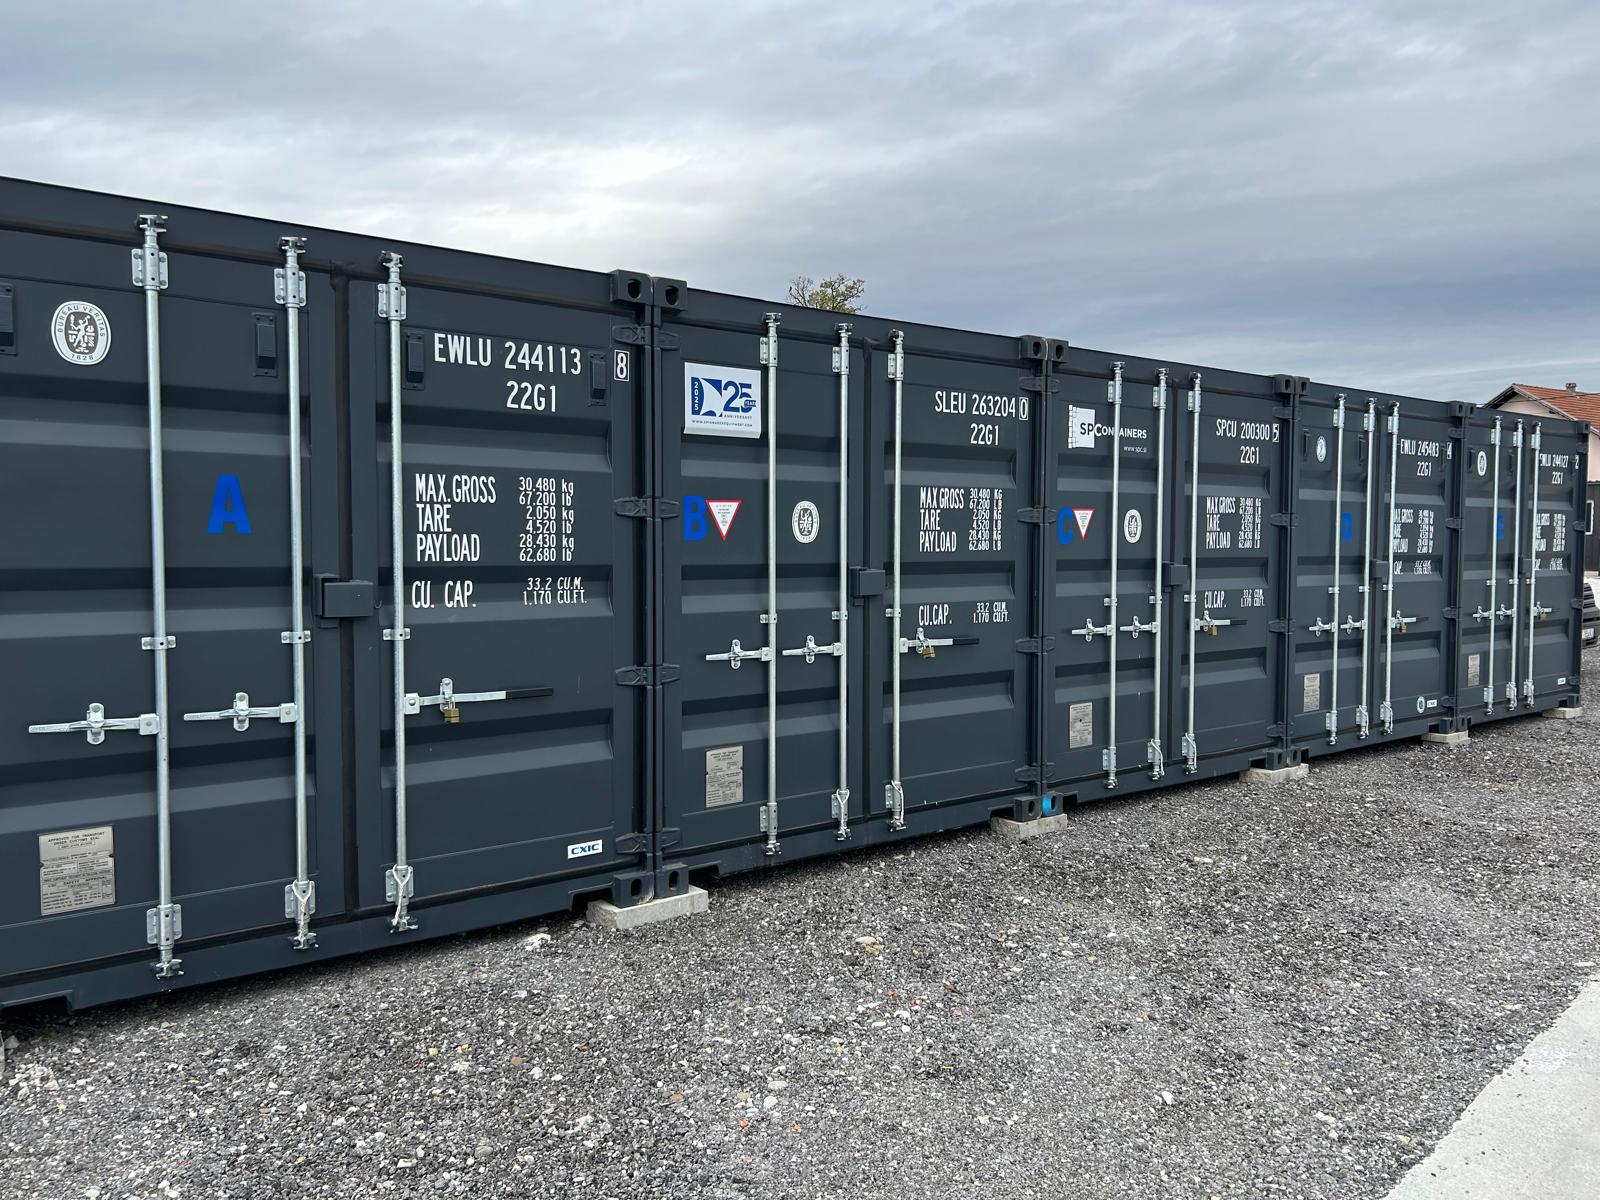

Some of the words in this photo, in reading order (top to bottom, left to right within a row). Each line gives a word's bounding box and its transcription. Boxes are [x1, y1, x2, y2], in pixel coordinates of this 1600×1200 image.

[434, 332, 492, 367] EWLU
[504, 341, 582, 375] 244113
[616, 352, 627, 379] 8
[506, 380, 557, 412] 22G1
[723, 380, 753, 413] 25
[935, 390, 967, 414] SLEU
[971, 393, 1016, 418] 263204
[1020, 398, 1027, 419] 0
[970, 423, 999, 446] 22G1
[1080, 422, 1147, 439] SPCONAINERS
[1216, 418, 1237, 438] SPCU
[1240, 422, 1270, 440] 200300
[1240, 445, 1259, 464] 22G1
[1400, 439, 1416, 455] EWLU
[1416, 461, 1432, 476] 22G1
[561, 478, 574, 497] kg
[207, 473, 252, 534] A
[562, 492, 572, 506] lb
[939, 488, 965, 509] GROSS
[993, 489, 1003, 499] KG
[993, 499, 1003, 509] LB
[416, 503, 452, 532] TARE
[562, 506, 575, 524] kg
[562, 520, 572, 534] lb
[683, 495, 708, 541] B
[919, 509, 941, 531] TARE
[993, 509, 1002, 520] KG
[993, 520, 1002, 530] LB
[1057, 506, 1073, 544] C
[1206, 514, 1220, 531] TARE
[1342, 511, 1353, 542] D
[416, 534, 481, 562] PAYLOAD
[562, 534, 575, 552] kg
[919, 531, 957, 552] PAYLOAD
[993, 530, 1002, 540] KG
[993, 540, 1002, 551] LB
[1206, 531, 1231, 549] PAYLOAD
[562, 548, 572, 561] lb
[411, 580, 435, 608] CU.
[444, 580, 477, 608] CAP.
[526, 577, 552, 590] 33.2
[557, 576, 584, 590] CU.M.
[557, 590, 588, 604] CU.FT.
[976, 602, 990, 612] 33.2
[571, 843, 599, 855] CXIC
